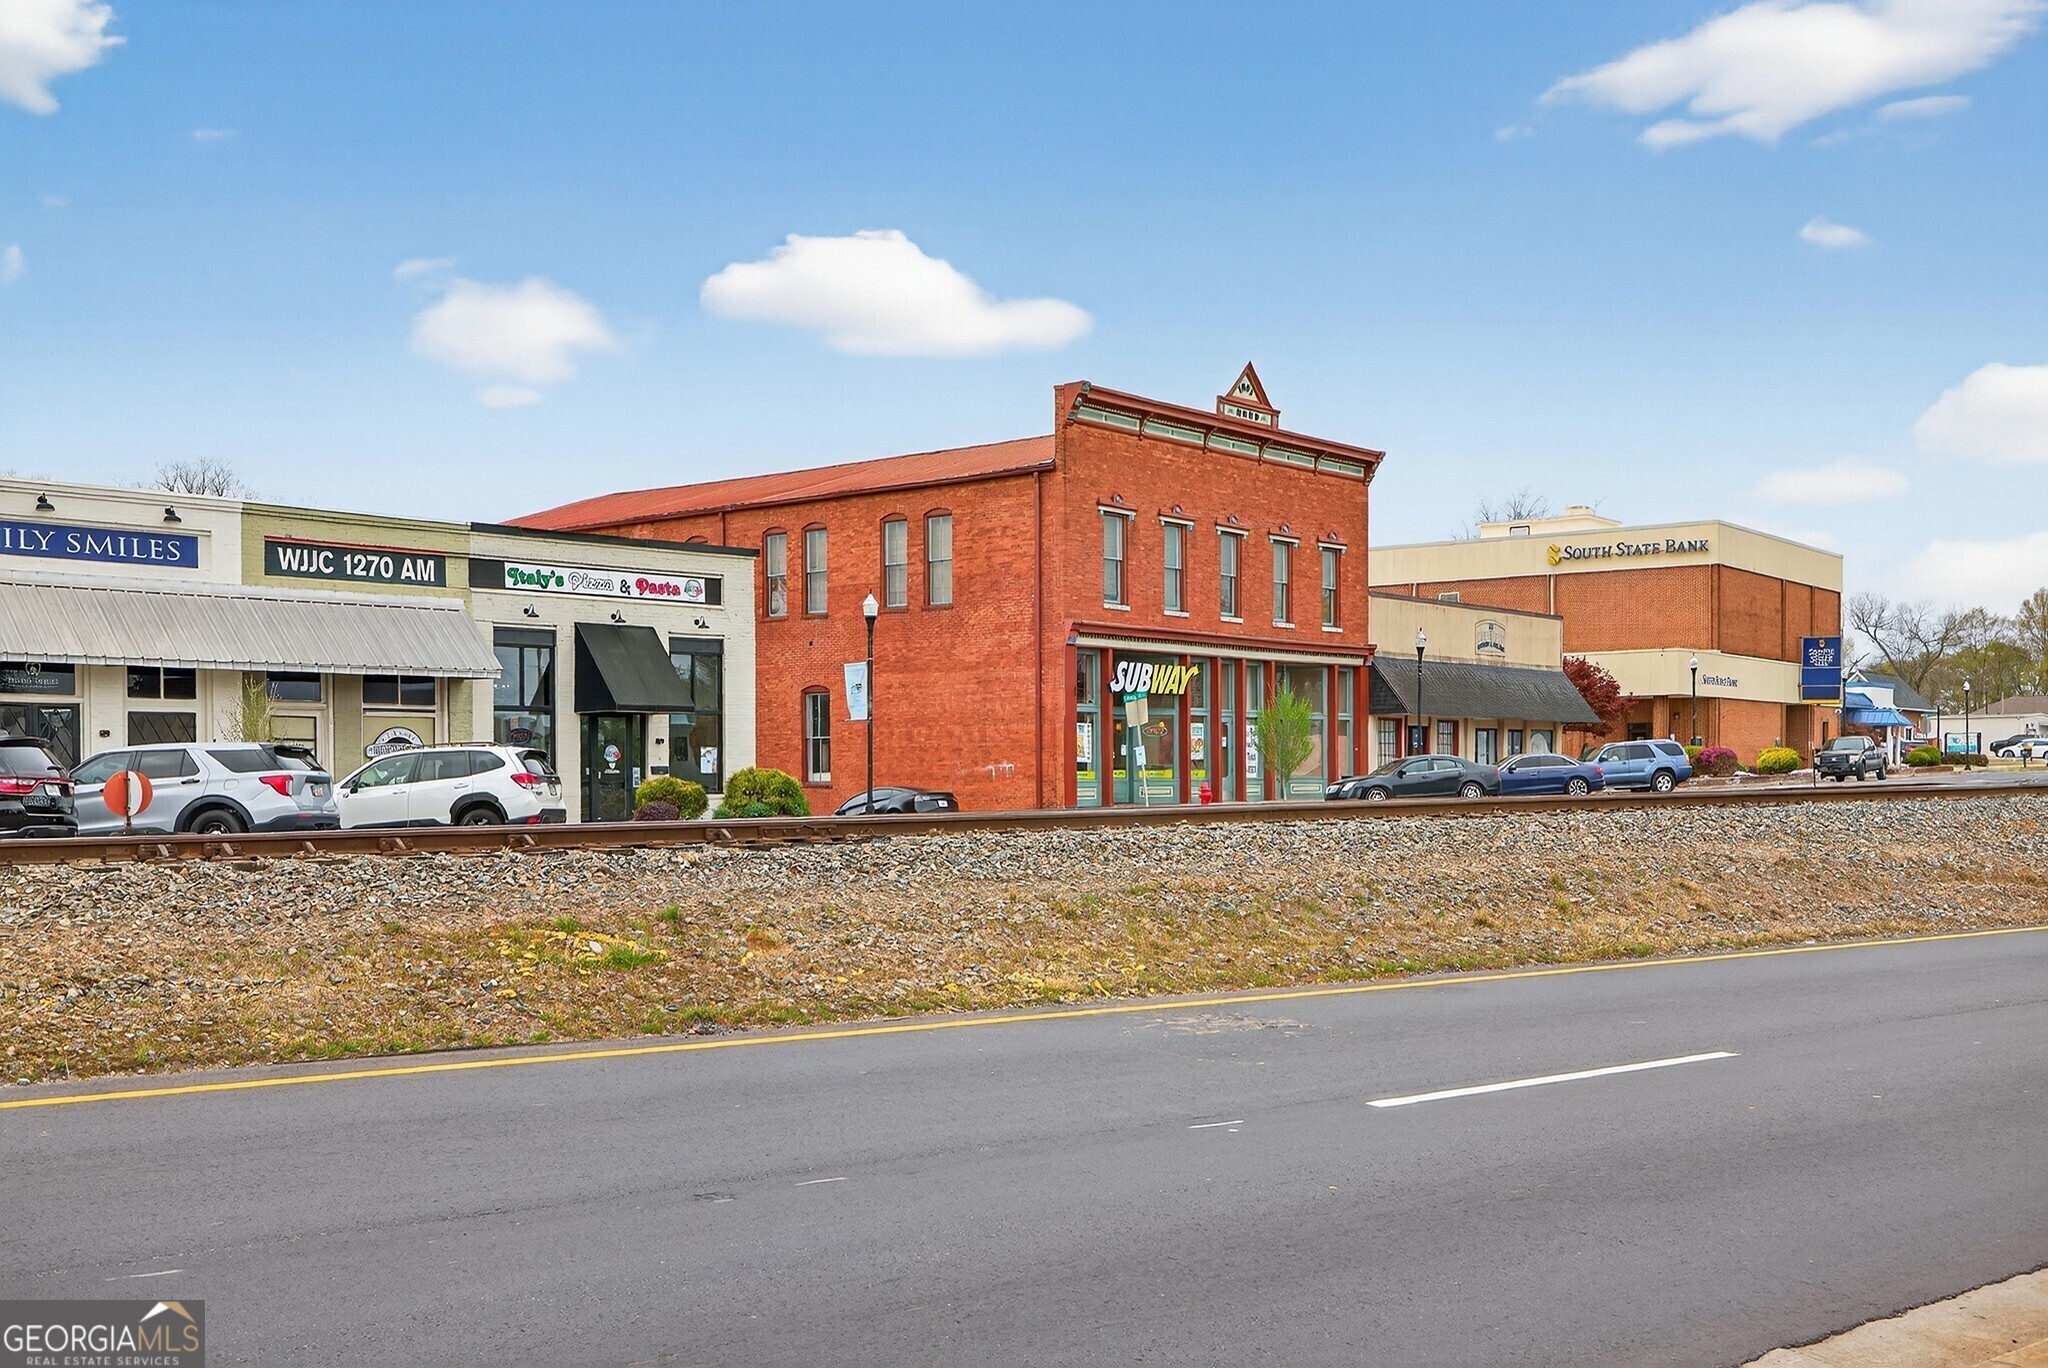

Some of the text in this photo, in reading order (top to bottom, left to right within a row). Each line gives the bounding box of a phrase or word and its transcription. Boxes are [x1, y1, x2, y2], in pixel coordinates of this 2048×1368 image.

[66, 533, 182, 562] SMILES
[277, 546, 435, 582] WJJC 1270 AM
[507, 566, 565, 589] Italy's
[619, 578, 631, 596] &
[635, 577, 681, 597] Pasta
[1109, 660, 1200, 695] SUBWAY
